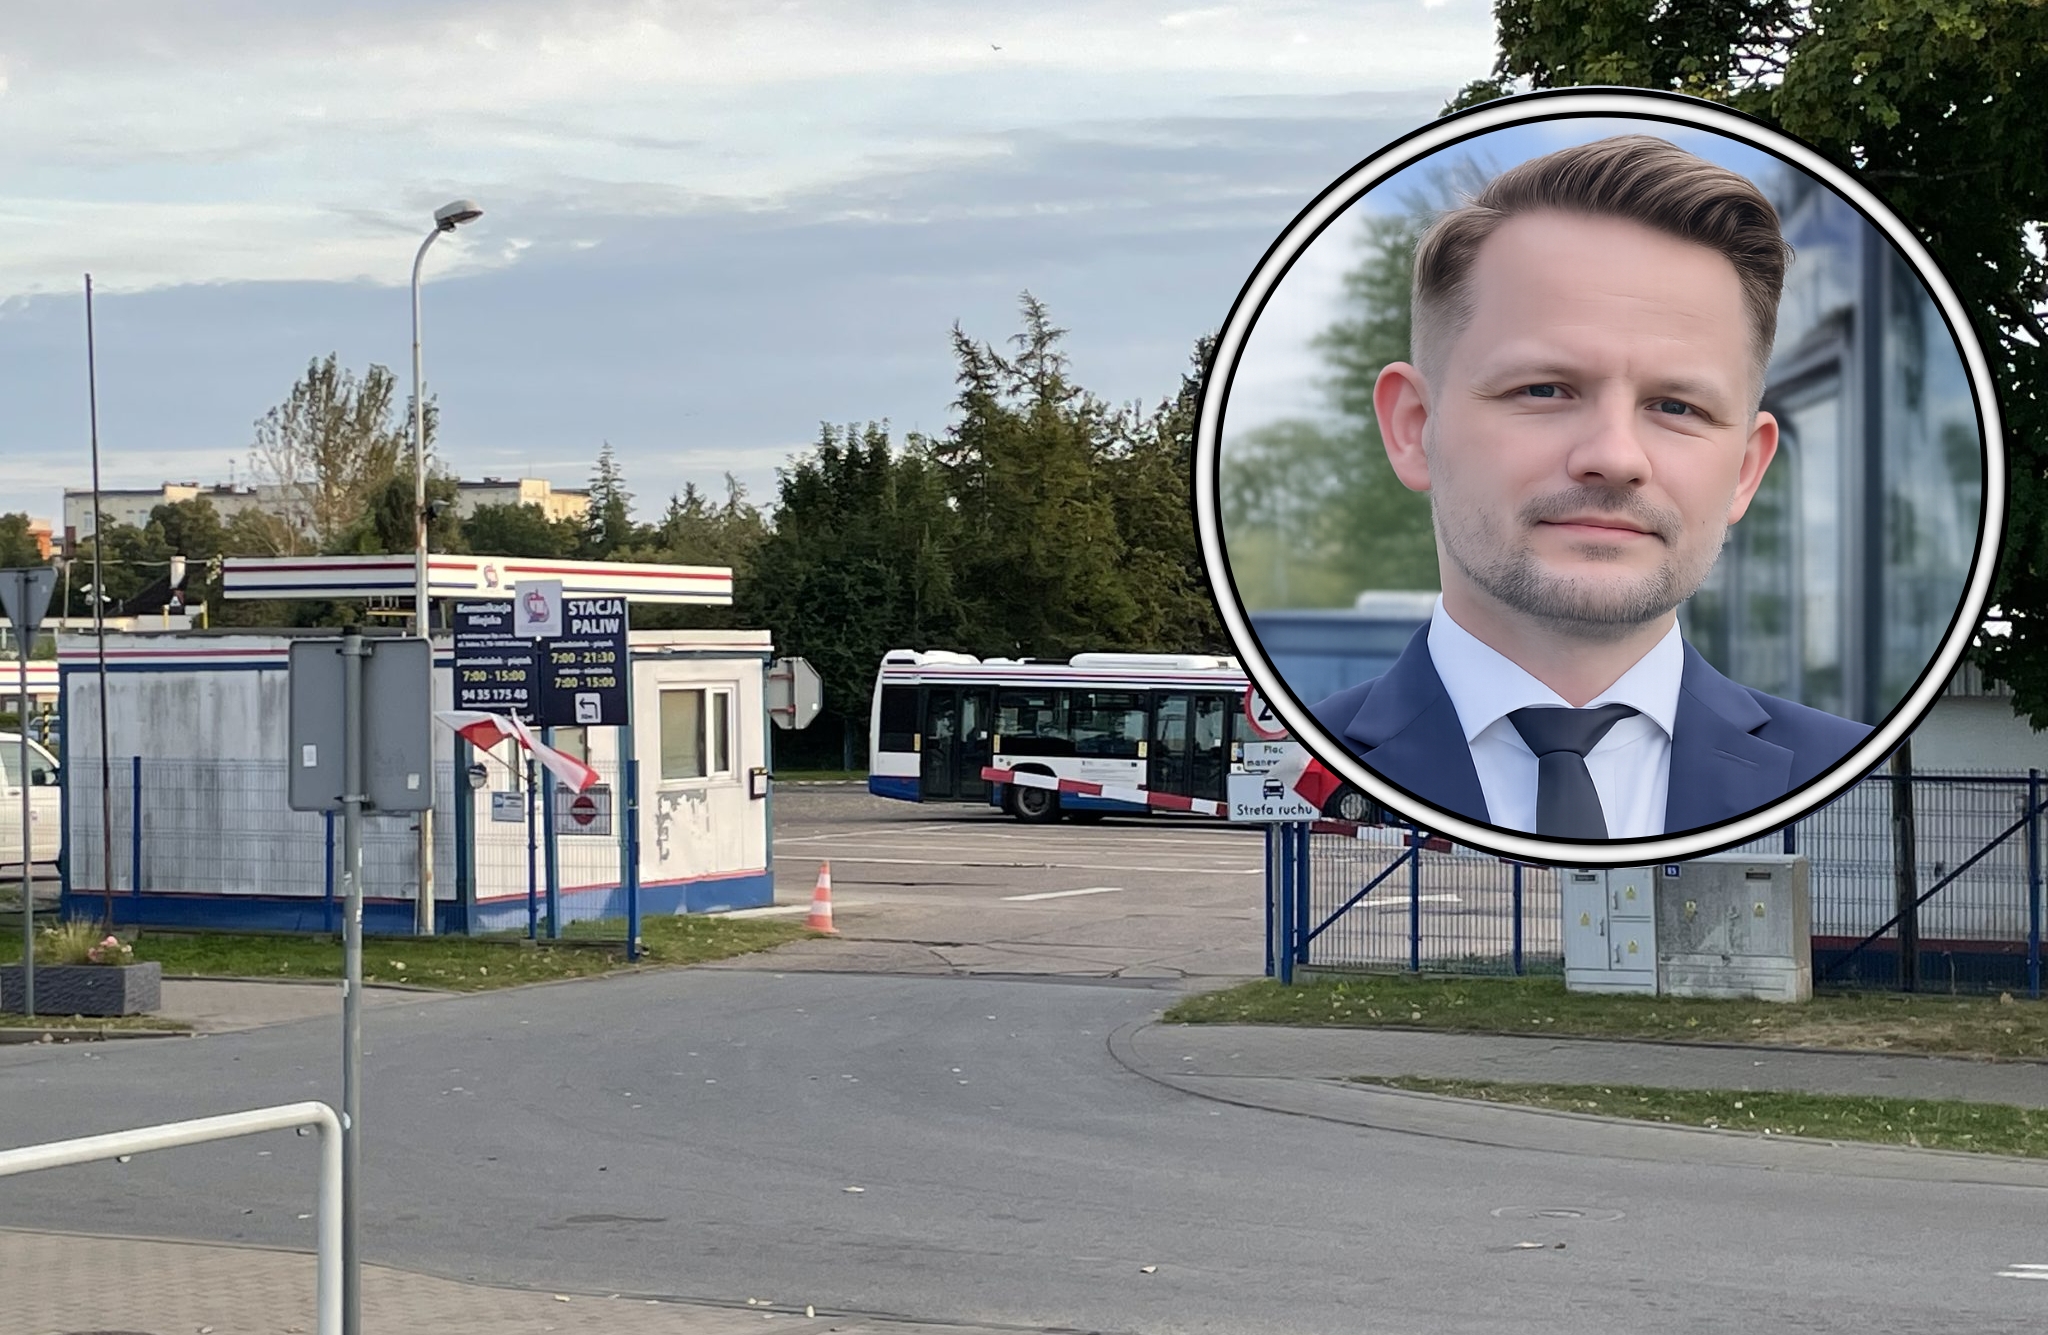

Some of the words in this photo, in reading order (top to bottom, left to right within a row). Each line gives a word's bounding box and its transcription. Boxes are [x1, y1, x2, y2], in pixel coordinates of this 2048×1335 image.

[568, 600, 623, 616] STACJA
[572, 618, 619, 634] PALIW
[551, 652, 576, 664] 7:00
[583, 651, 616, 664] 21:30
[462, 670, 487, 681] 7:00
[495, 669, 526, 681] 15:00
[554, 677, 579, 688] 7:00
[586, 676, 616, 689] 15:00
[461, 689, 476, 700] 94
[492, 688, 512, 700] 175
[1264, 745, 1284, 754] Plac
[1236, 803, 1274, 816] Strefa
[1278, 803, 1312, 815] ruchu
